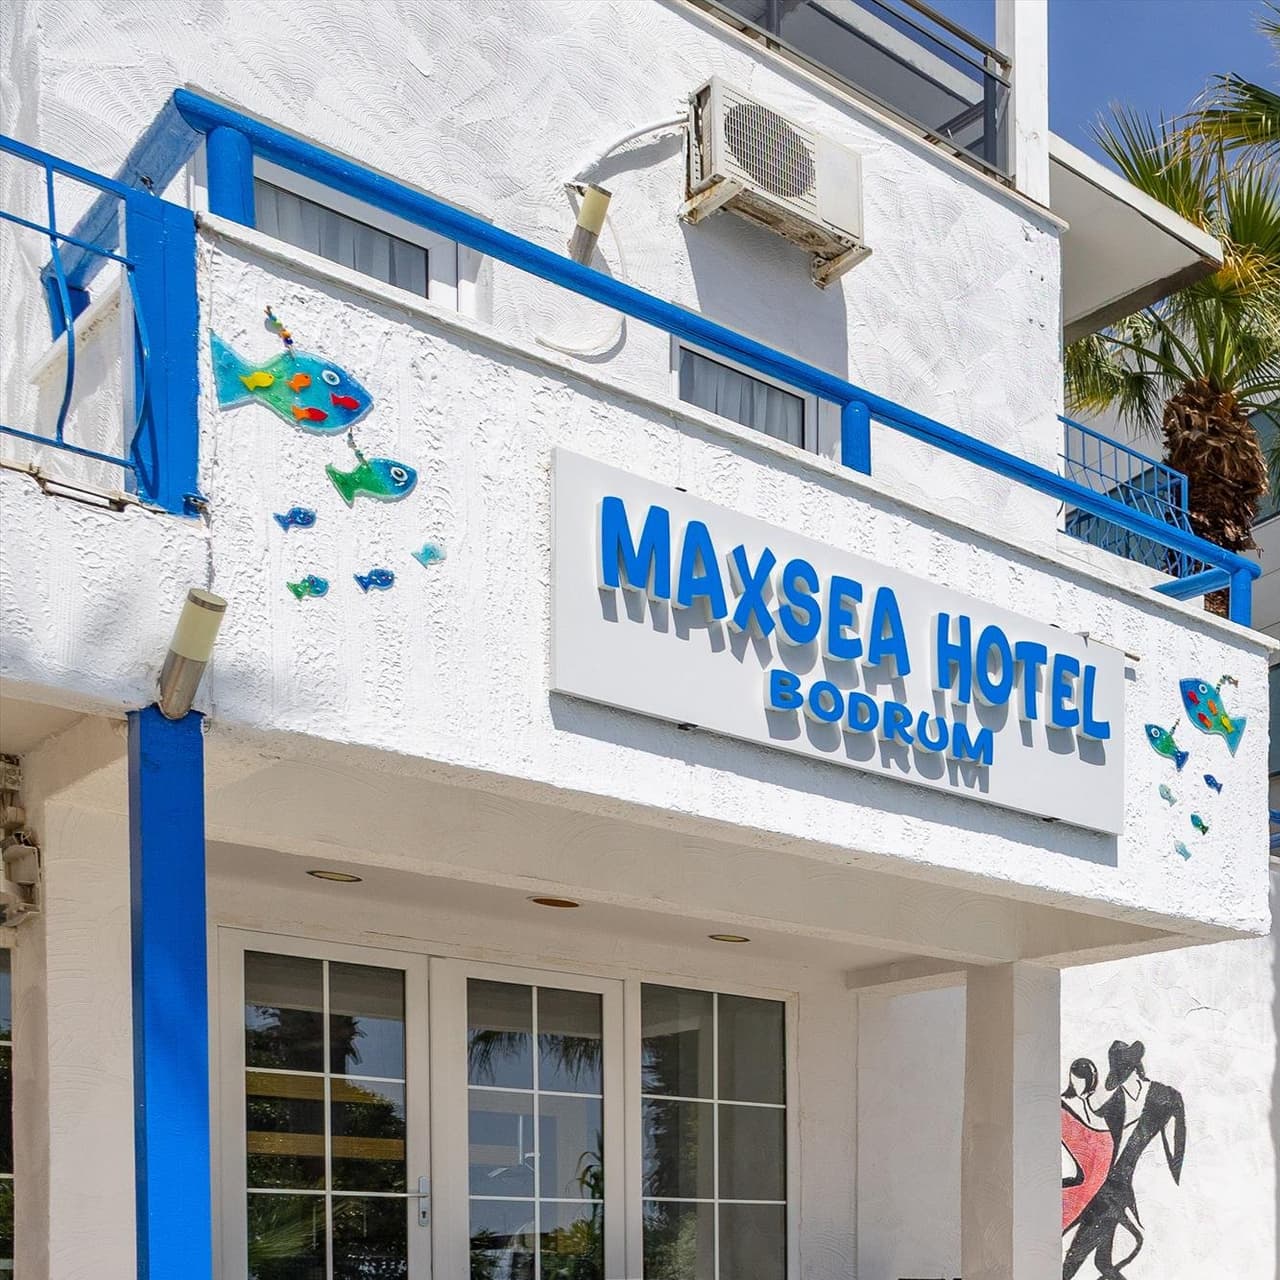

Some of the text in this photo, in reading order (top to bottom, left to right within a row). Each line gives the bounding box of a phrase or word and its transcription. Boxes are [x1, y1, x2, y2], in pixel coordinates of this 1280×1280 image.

[600, 495, 1111, 740] MAXSEA HOTEL
[768, 669, 994, 766] BODRUM
